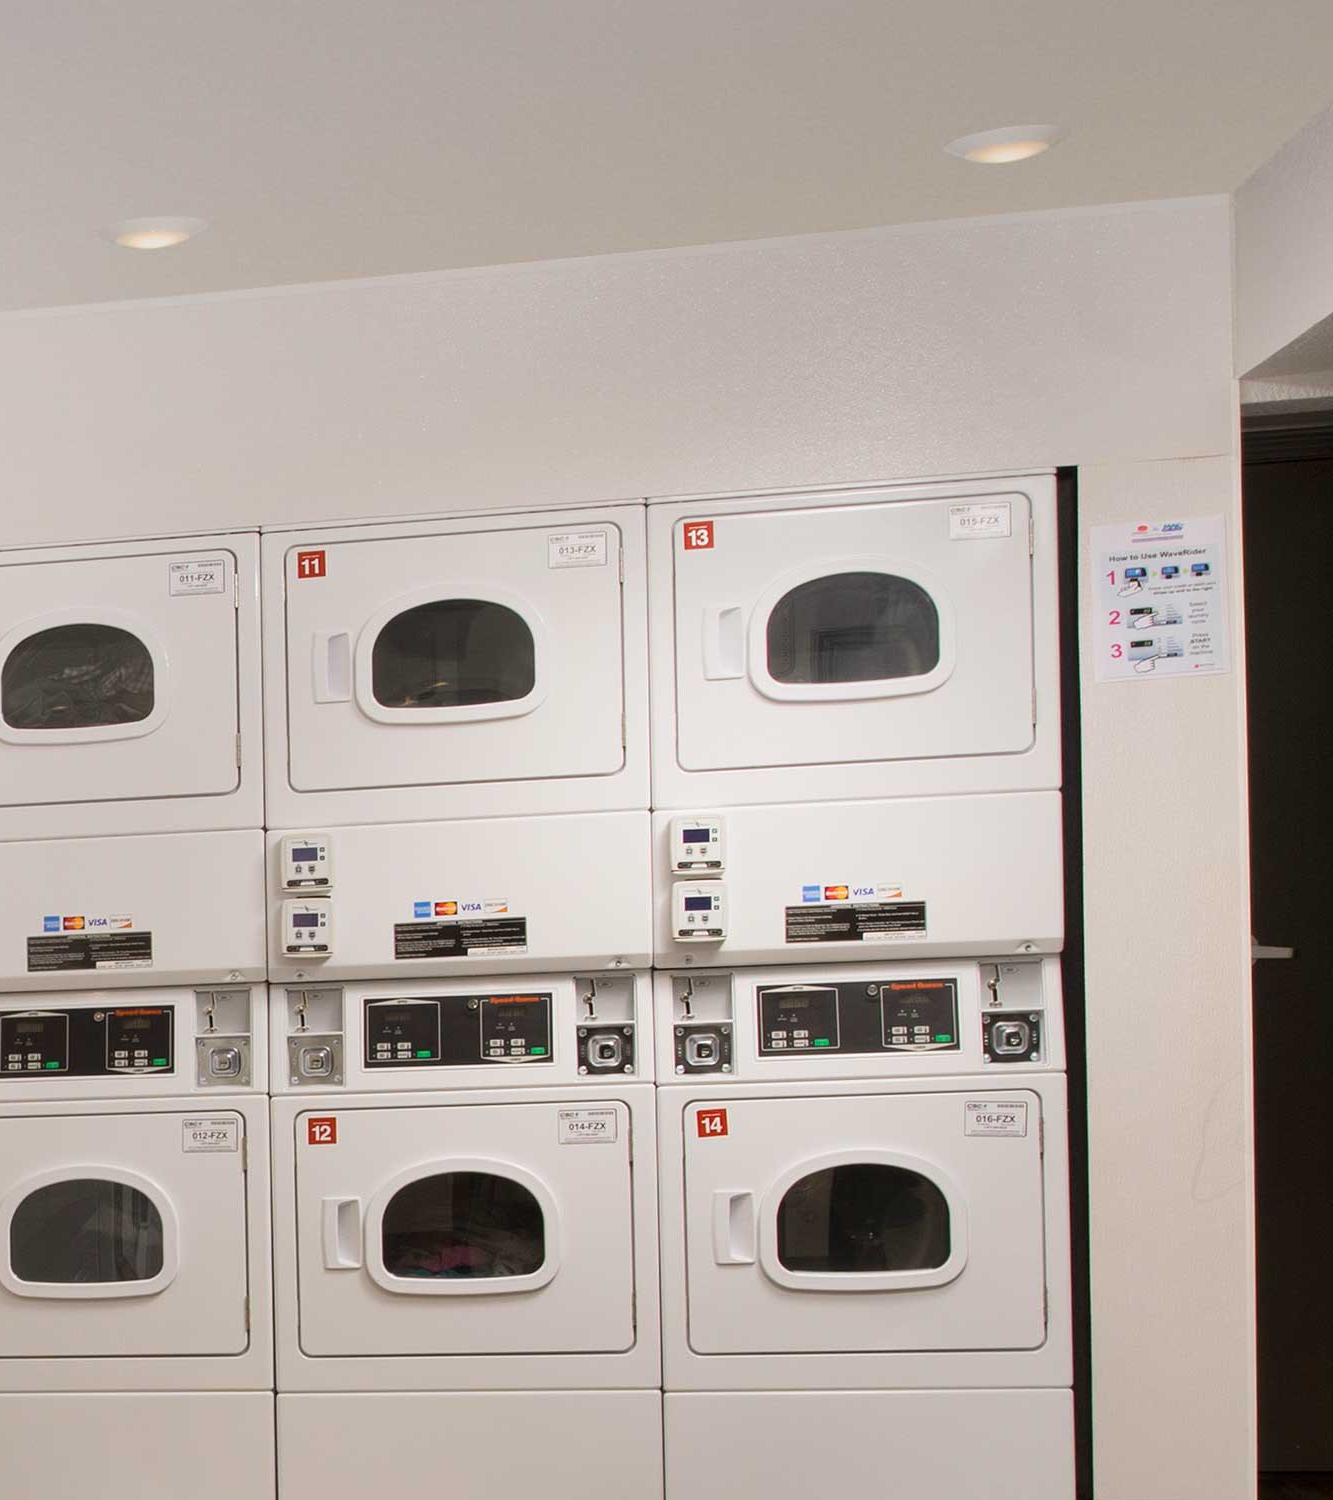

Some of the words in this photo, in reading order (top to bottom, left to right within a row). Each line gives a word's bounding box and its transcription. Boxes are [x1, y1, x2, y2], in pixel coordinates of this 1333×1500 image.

[687, 527, 710, 547] 13
[558, 544, 597, 555] 013-FZX
[1109, 555, 1127, 563] How
[1130, 553, 1138, 561] to
[1141, 551, 1157, 560] Use
[1159, 548, 1207, 558] WaveRider
[300, 558, 321, 576] 11
[179, 573, 215, 584] 011-FZX
[1107, 570, 1116, 586] 1
[1109, 610, 1121, 626] 2
[1111, 643, 1123, 659] 3
[853, 887, 875, 896] VISA
[461, 903, 482, 912] VISA
[88, 918, 108, 927] VISA
[701, 1115, 723, 1134] 14
[975, 1114, 1016, 1125] 016-FZX
[311, 1123, 332, 1142] 12
[568, 1122, 606, 1132] 014-FZX
[191, 1131, 228, 1141] 012-FZX
